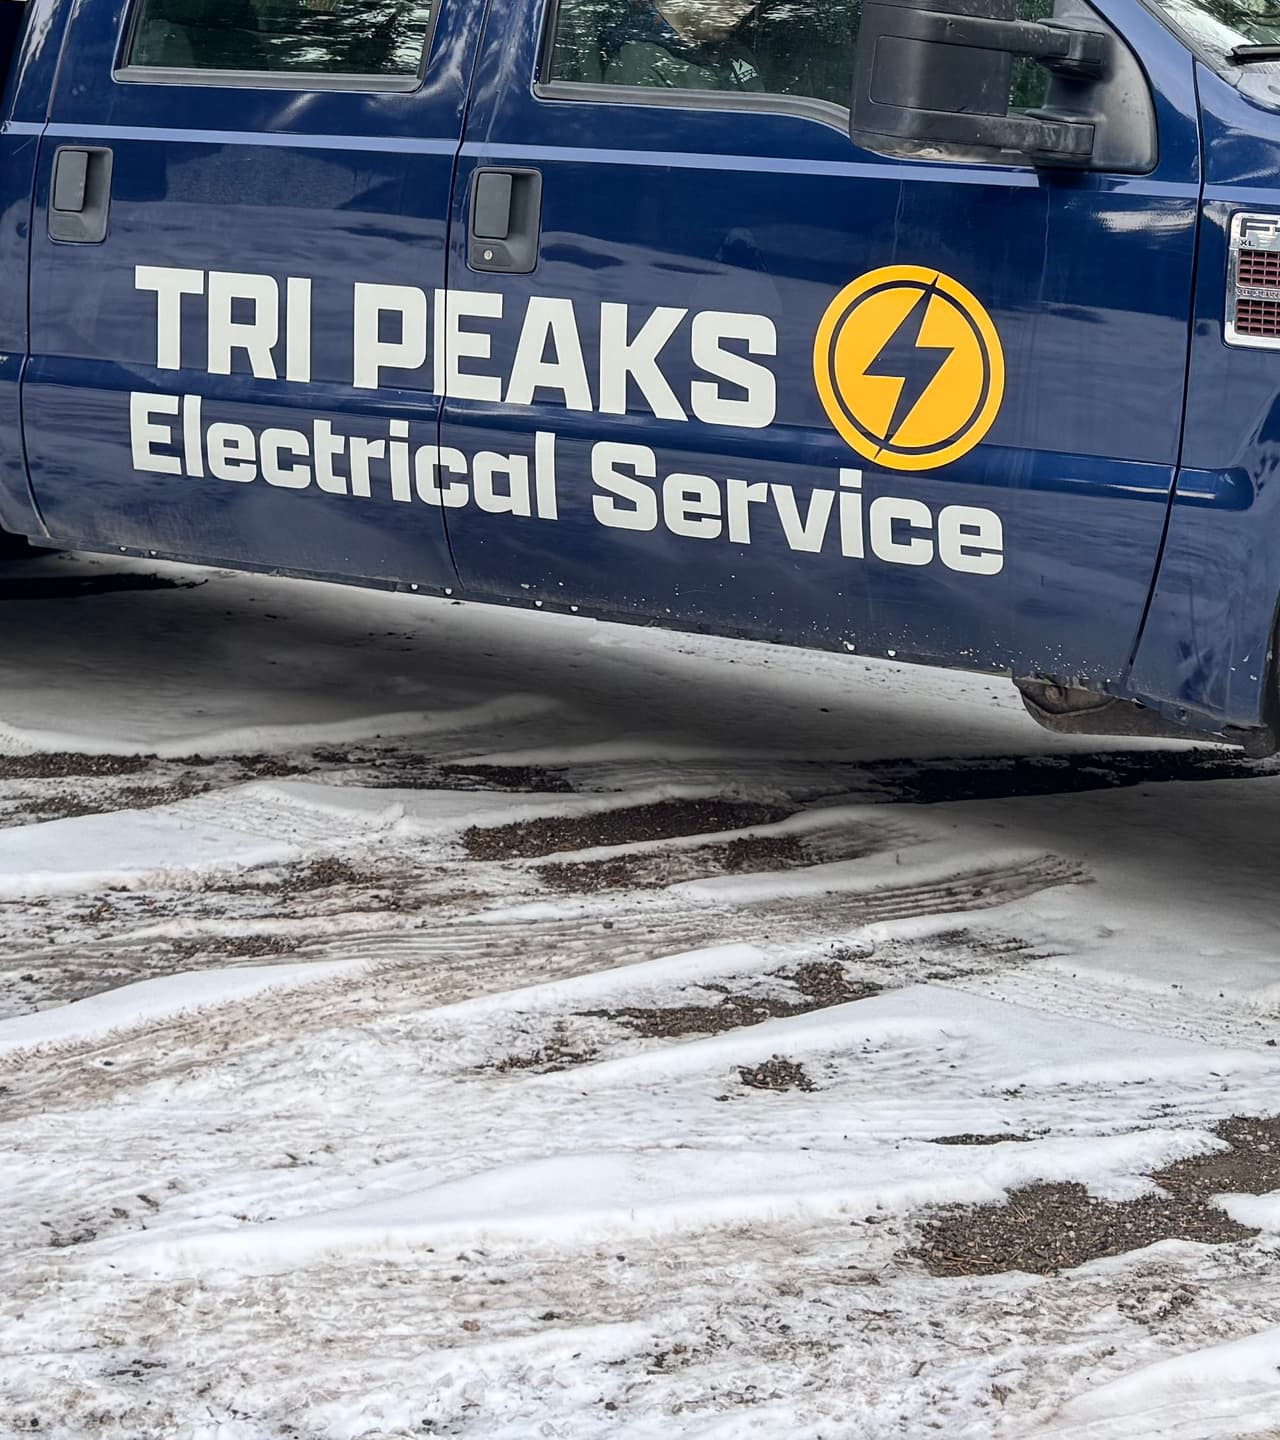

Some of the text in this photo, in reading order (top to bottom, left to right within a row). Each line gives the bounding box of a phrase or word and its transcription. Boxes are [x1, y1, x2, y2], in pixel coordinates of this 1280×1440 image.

[1240, 239, 1256, 247] XL
[134, 265, 777, 429] TRI PEAKS
[128, 392, 1005, 576] Electrical Service
